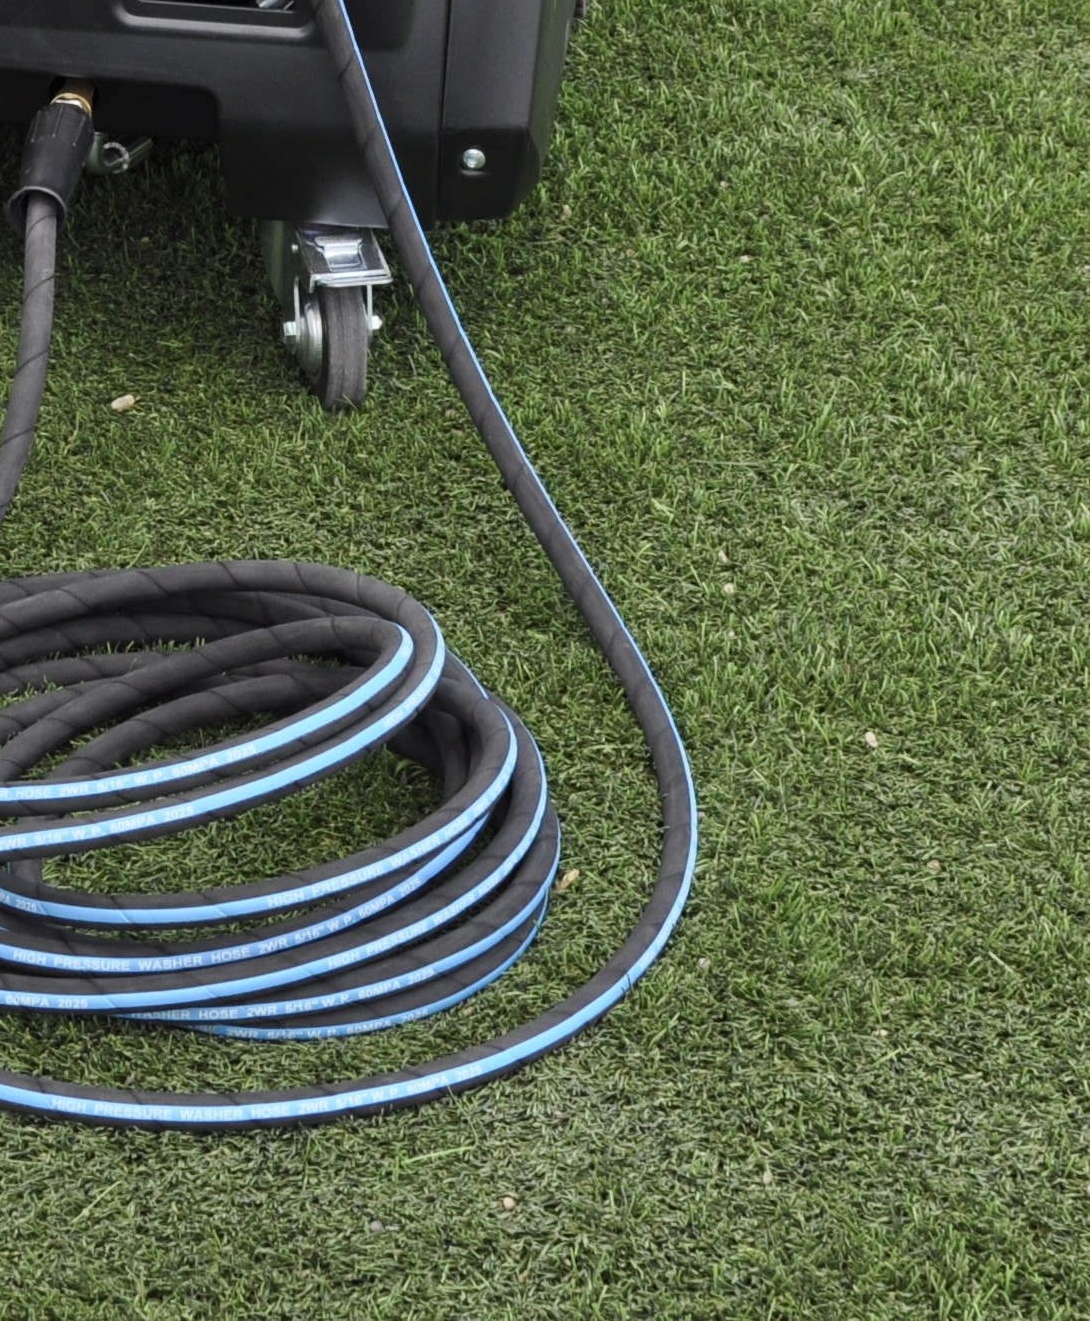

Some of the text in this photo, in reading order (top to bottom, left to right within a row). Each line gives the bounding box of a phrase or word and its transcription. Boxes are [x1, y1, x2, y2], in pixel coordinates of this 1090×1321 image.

[16, 787, 51, 799] HOSE
[60, 785, 89, 796] 2WR
[228, 745, 256, 761] 2025
[112, 815, 155, 832] 60MPA
[164, 806, 194, 820] 2025
[267, 890, 304, 908] HIGH
[312, 863, 384, 896] PRESSURE
[390, 836, 440, 866] WASHER
[13, 950, 46, 966] HIGH
[54, 957, 130, 971] PRESSURE
[138, 955, 203, 971] WASHER
[211, 947, 250, 963] HOSE
[259, 938, 288, 954] 2WR
[295, 926, 324, 944] 5/16"
[359, 894, 395, 919] 60MPA
[399, 878, 421, 897] 2025
[328, 950, 360, 968] HIGH
[366, 920, 428, 955] PRESSURE
[433, 894, 475, 926] WASHER
[5, 994, 50, 1007] 60MPA
[58, 997, 88, 1008] 2025
[198, 1009, 238, 1019] HOSE
[247, 1005, 277, 1017] 2WR
[358, 980, 400, 998] 60MPA
[52, 1097, 87, 1112] HIGH
[94, 1104, 173, 1120] PRESSURE
[180, 1109, 243, 1121] WASHER
[251, 1105, 290, 1118] HOSE
[299, 1101, 328, 1114] 2WR
[456, 1065, 483, 1080] 2025
